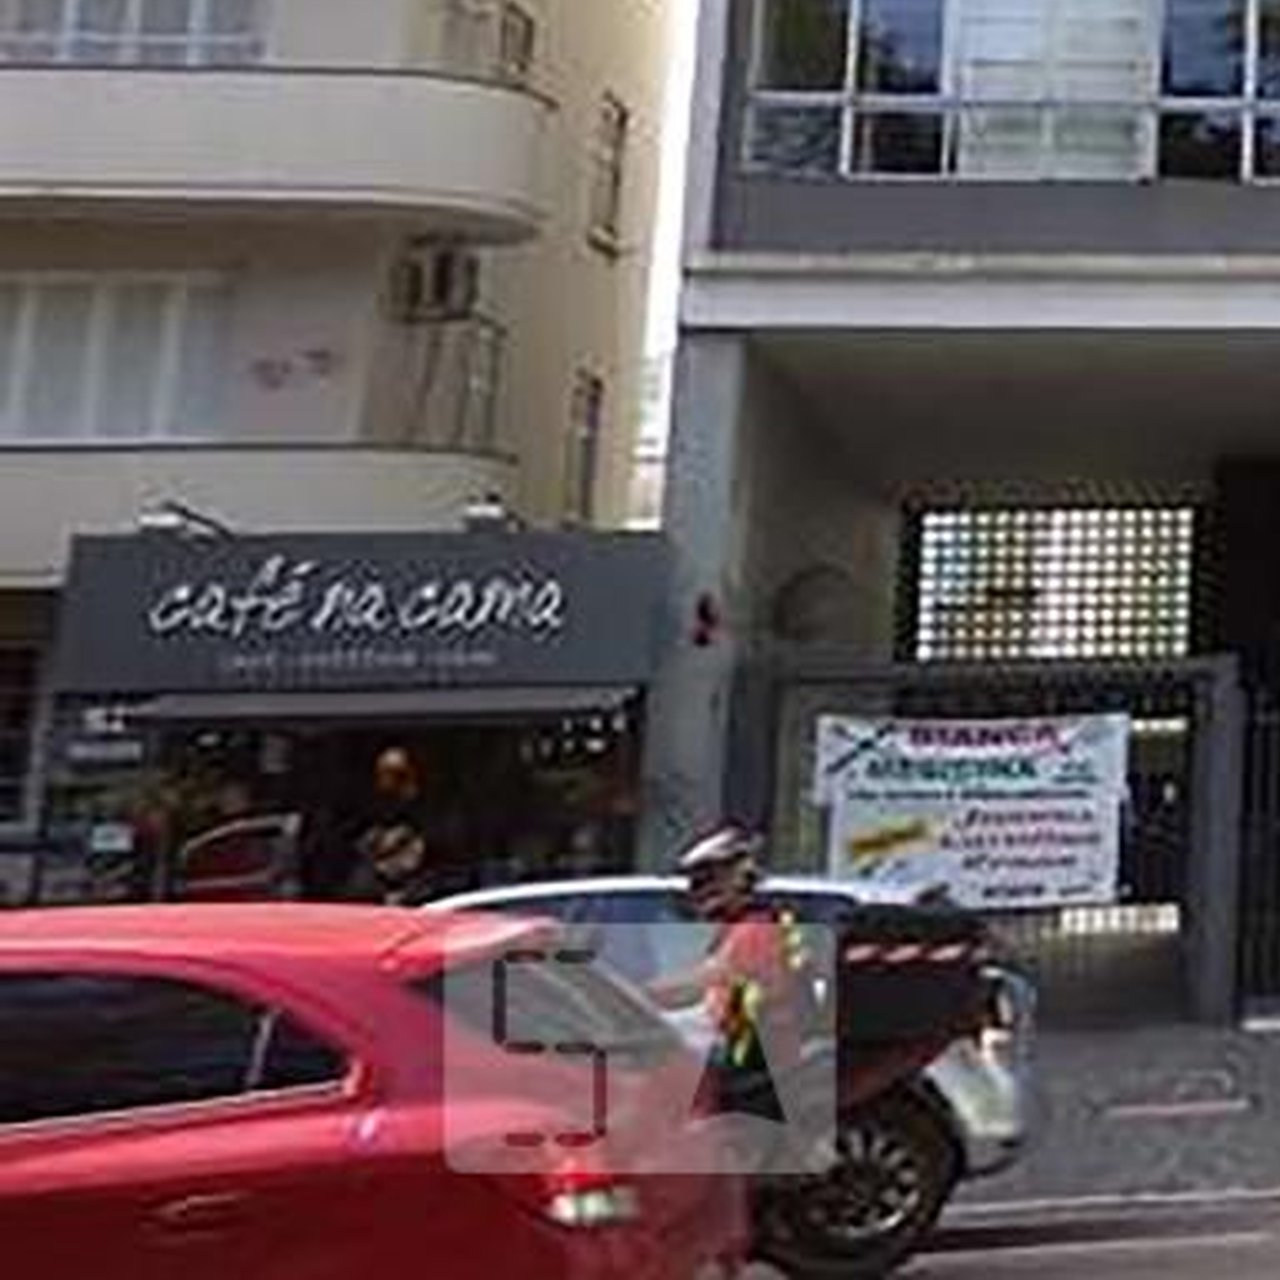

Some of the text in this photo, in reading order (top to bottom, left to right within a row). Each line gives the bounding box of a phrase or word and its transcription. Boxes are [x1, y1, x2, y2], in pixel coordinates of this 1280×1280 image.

[149, 554, 563, 637] café na cama
